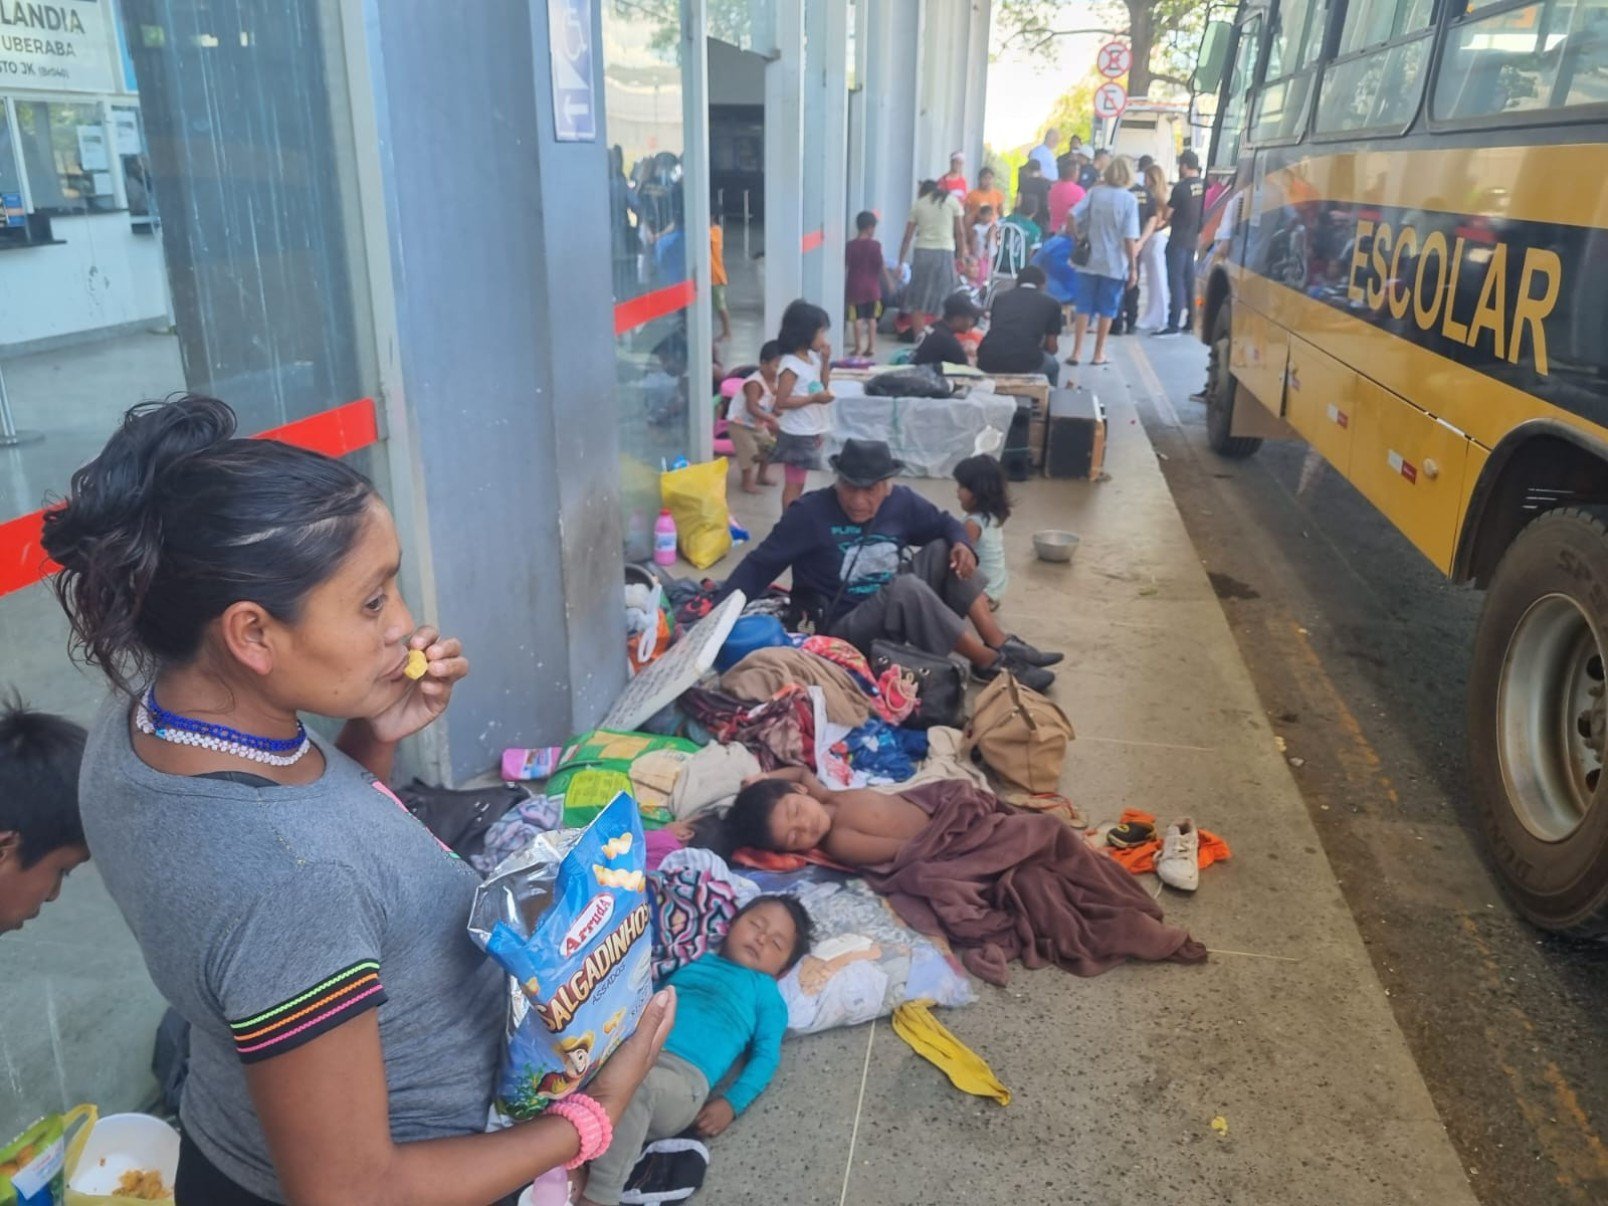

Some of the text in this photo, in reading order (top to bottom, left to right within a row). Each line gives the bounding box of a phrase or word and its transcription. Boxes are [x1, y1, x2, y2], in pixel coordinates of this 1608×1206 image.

[2, 35, 77, 57] UBERABA
[21, 63, 35, 76] JK
[1348, 219, 1562, 376] ESCOLAR
[592, 963, 627, 1006] ASSADOS
